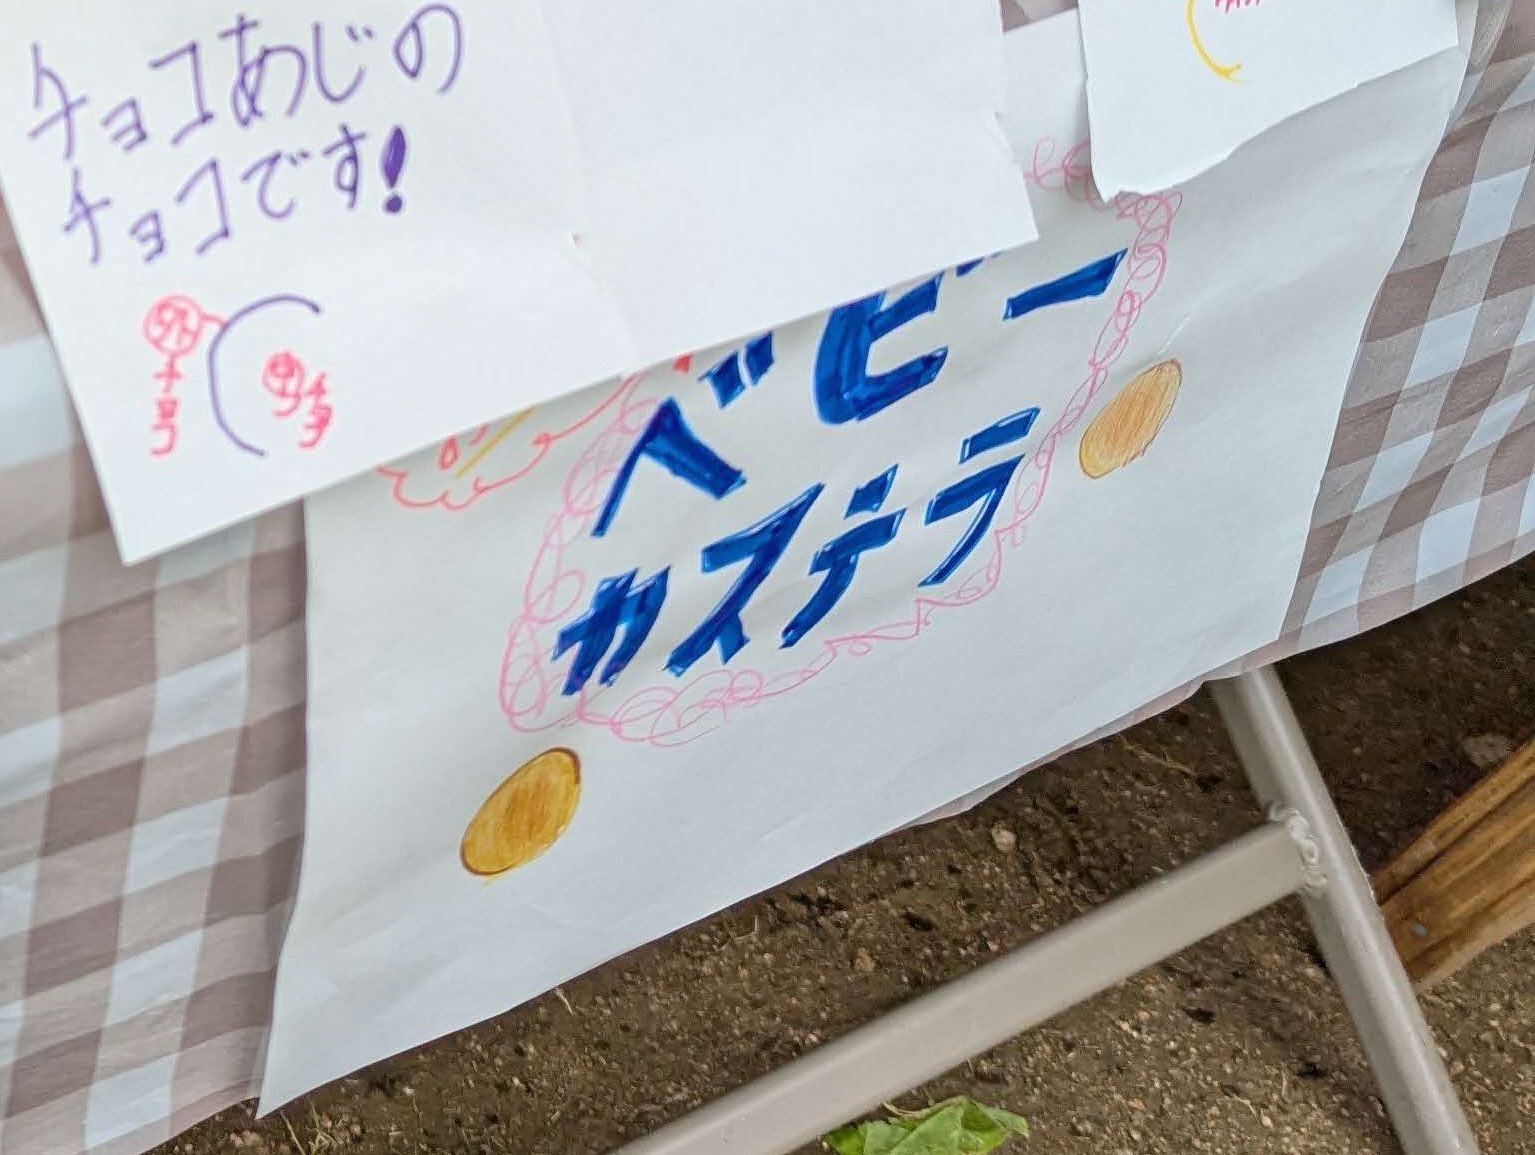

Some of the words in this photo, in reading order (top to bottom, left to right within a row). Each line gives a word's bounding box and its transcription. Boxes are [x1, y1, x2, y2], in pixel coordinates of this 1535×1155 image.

[28, 2, 464, 161] チョコあじの
[63, 122, 408, 265] チョコです!
[590, 247, 1130, 539] ベビー
[551, 405, 1043, 697] カステラ
